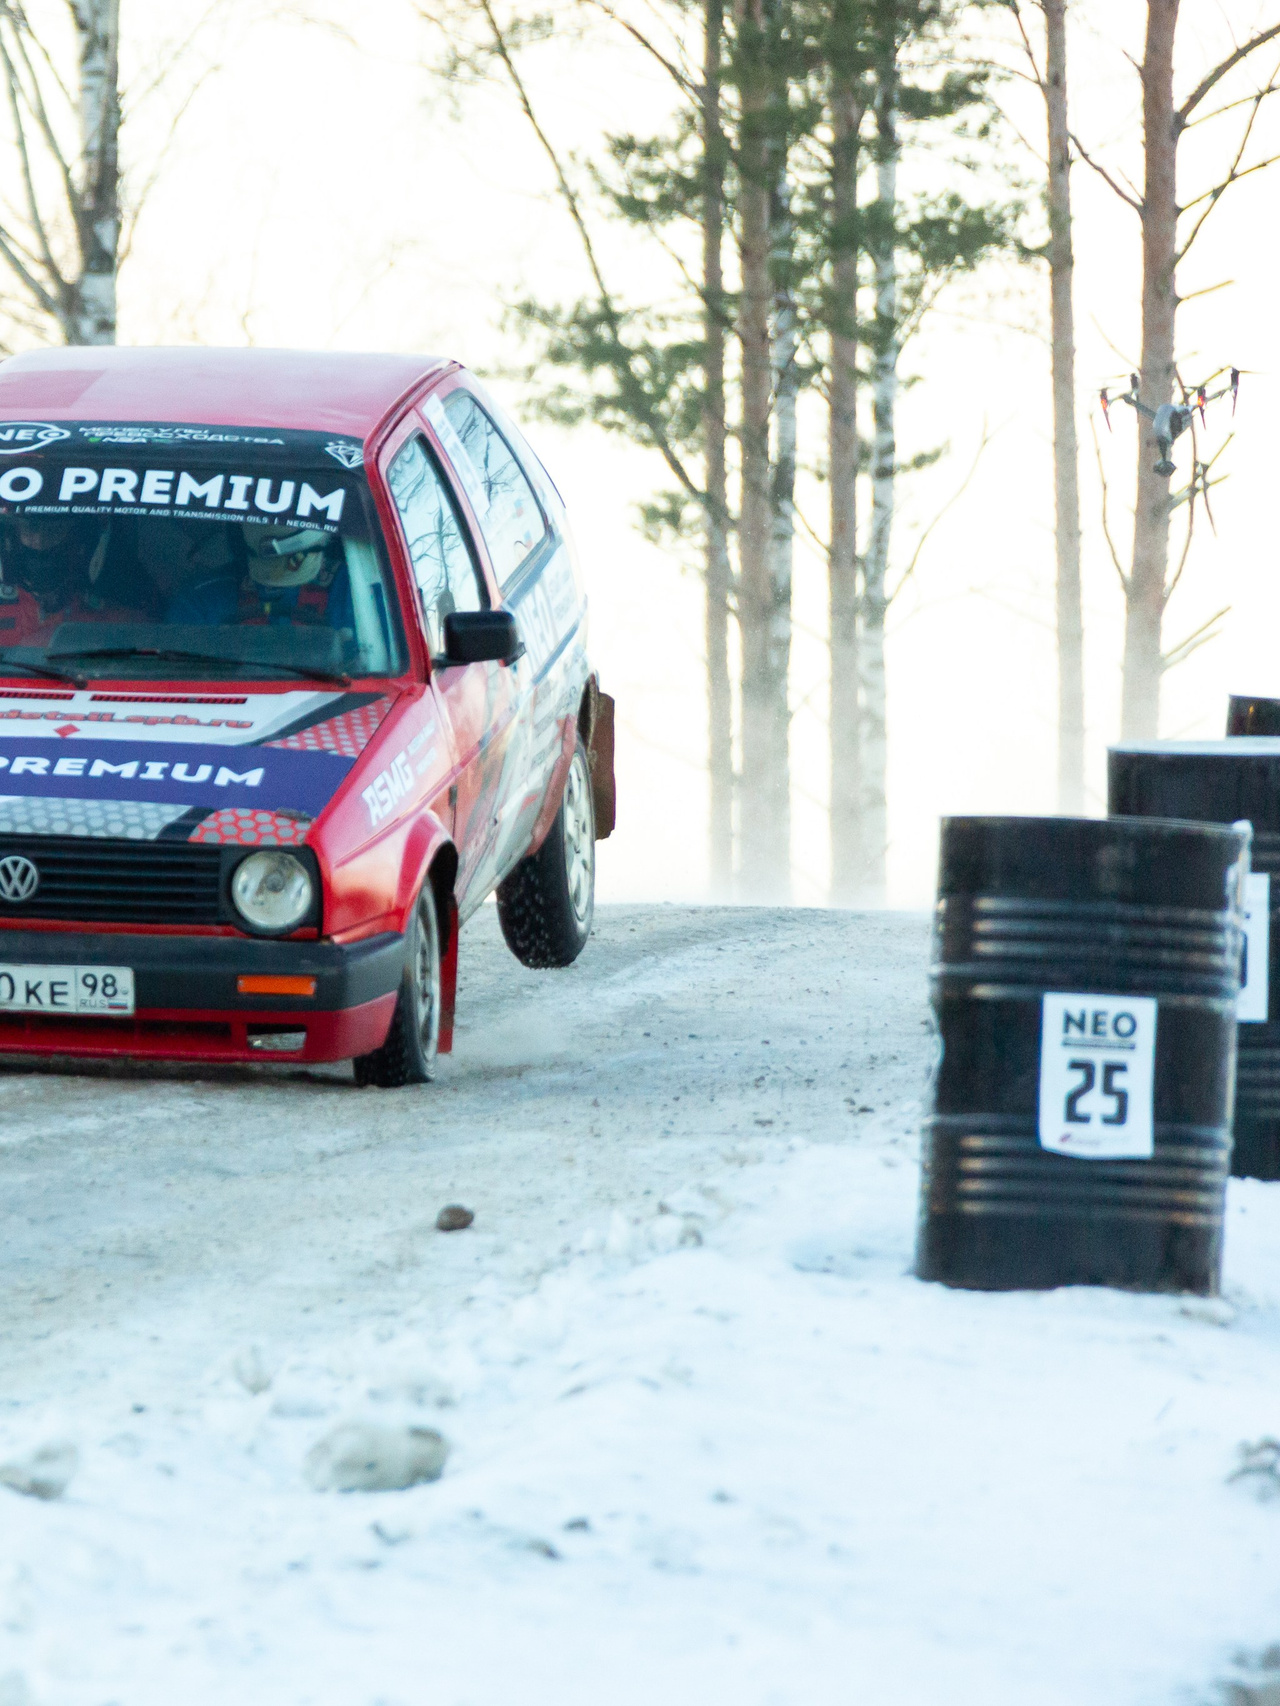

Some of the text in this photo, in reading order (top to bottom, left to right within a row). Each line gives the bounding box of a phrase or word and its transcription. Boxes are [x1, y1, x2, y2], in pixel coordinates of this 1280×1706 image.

[58, 467, 345, 522] PREMIUM
[24, 505, 69, 514] PREMIUM
[72, 506, 111, 514] QUALITY
[113, 507, 147, 515] MOTOR
[149, 508, 170, 517] AND
[173, 510, 244, 522] TRANSMISSION
[246, 516, 269, 525] OILS
[82, 973, 118, 998] 98
[79, 999, 107, 1008] RUS
[1063, 1009, 1137, 1038] NEO
[1065, 1061, 1129, 1125] 25
